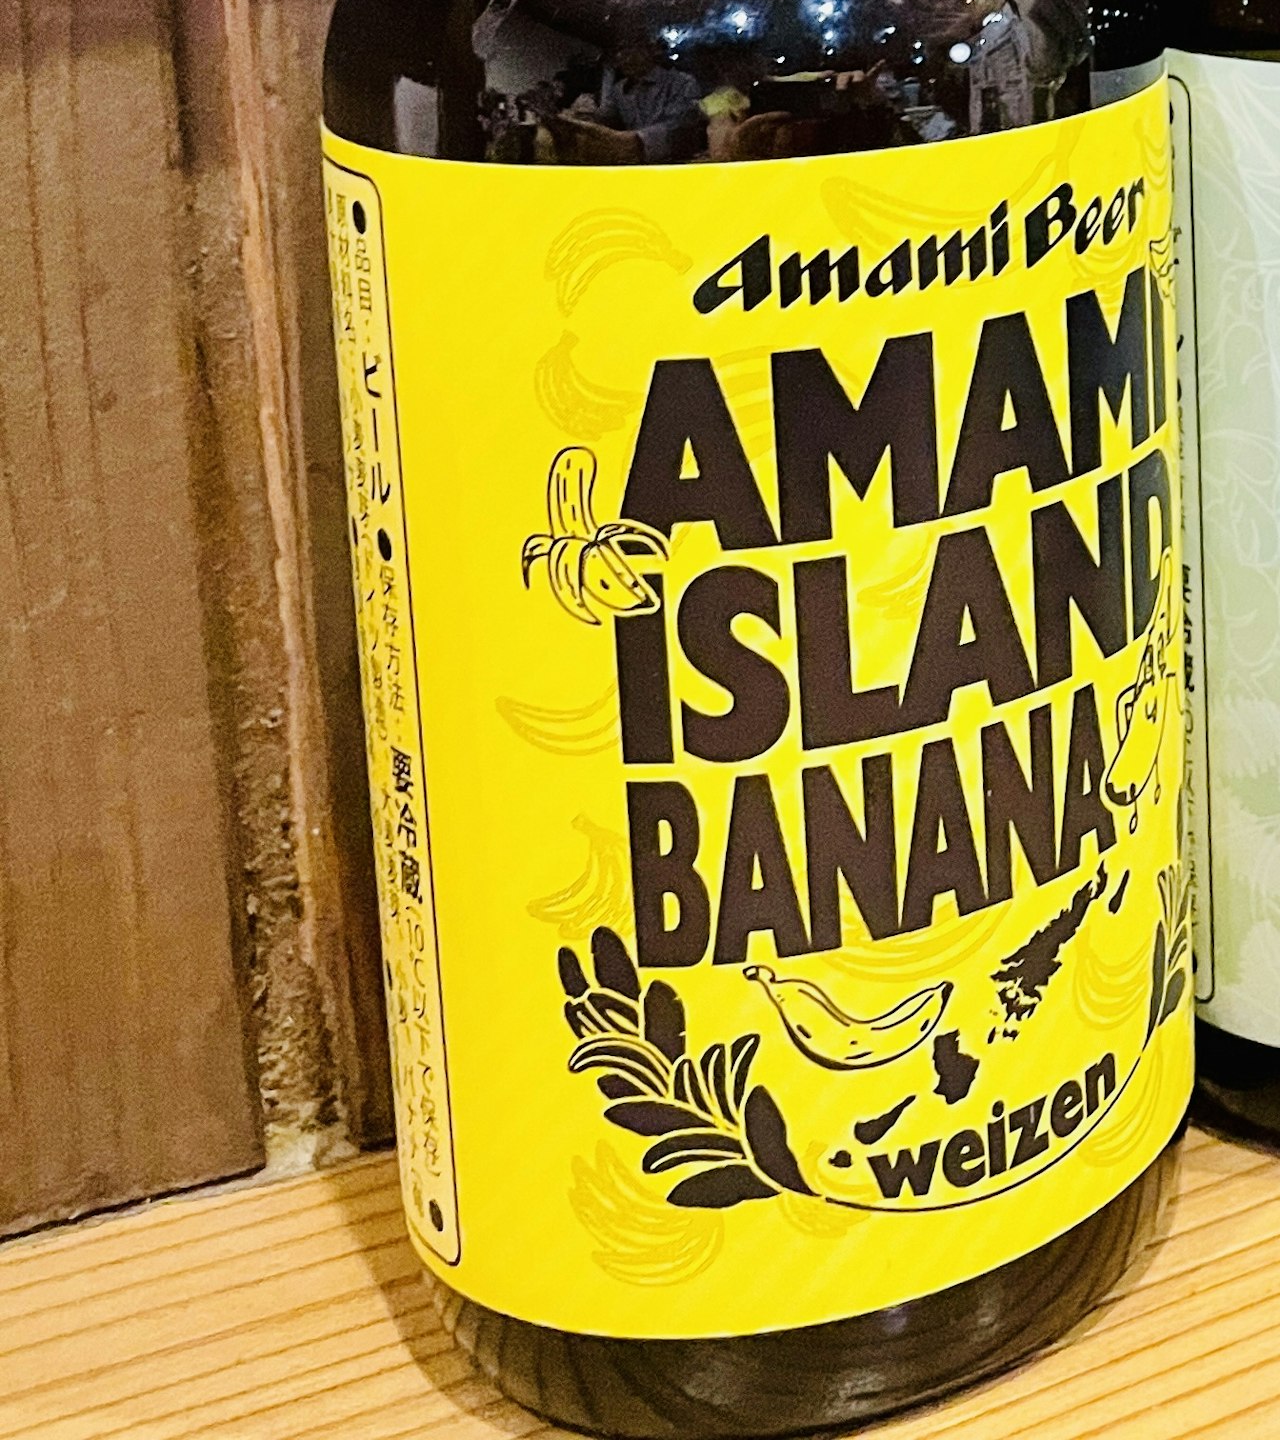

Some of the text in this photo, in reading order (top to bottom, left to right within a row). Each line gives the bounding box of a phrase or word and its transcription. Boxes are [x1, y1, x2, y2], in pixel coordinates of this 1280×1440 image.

[692, 175, 1146, 315] Amami Beer
[619, 268, 1168, 554] AMAMI
[614, 450, 1173, 766] ISLAND
[625, 682, 1117, 970] BANANA
[865, 1054, 1118, 1199] weizen
